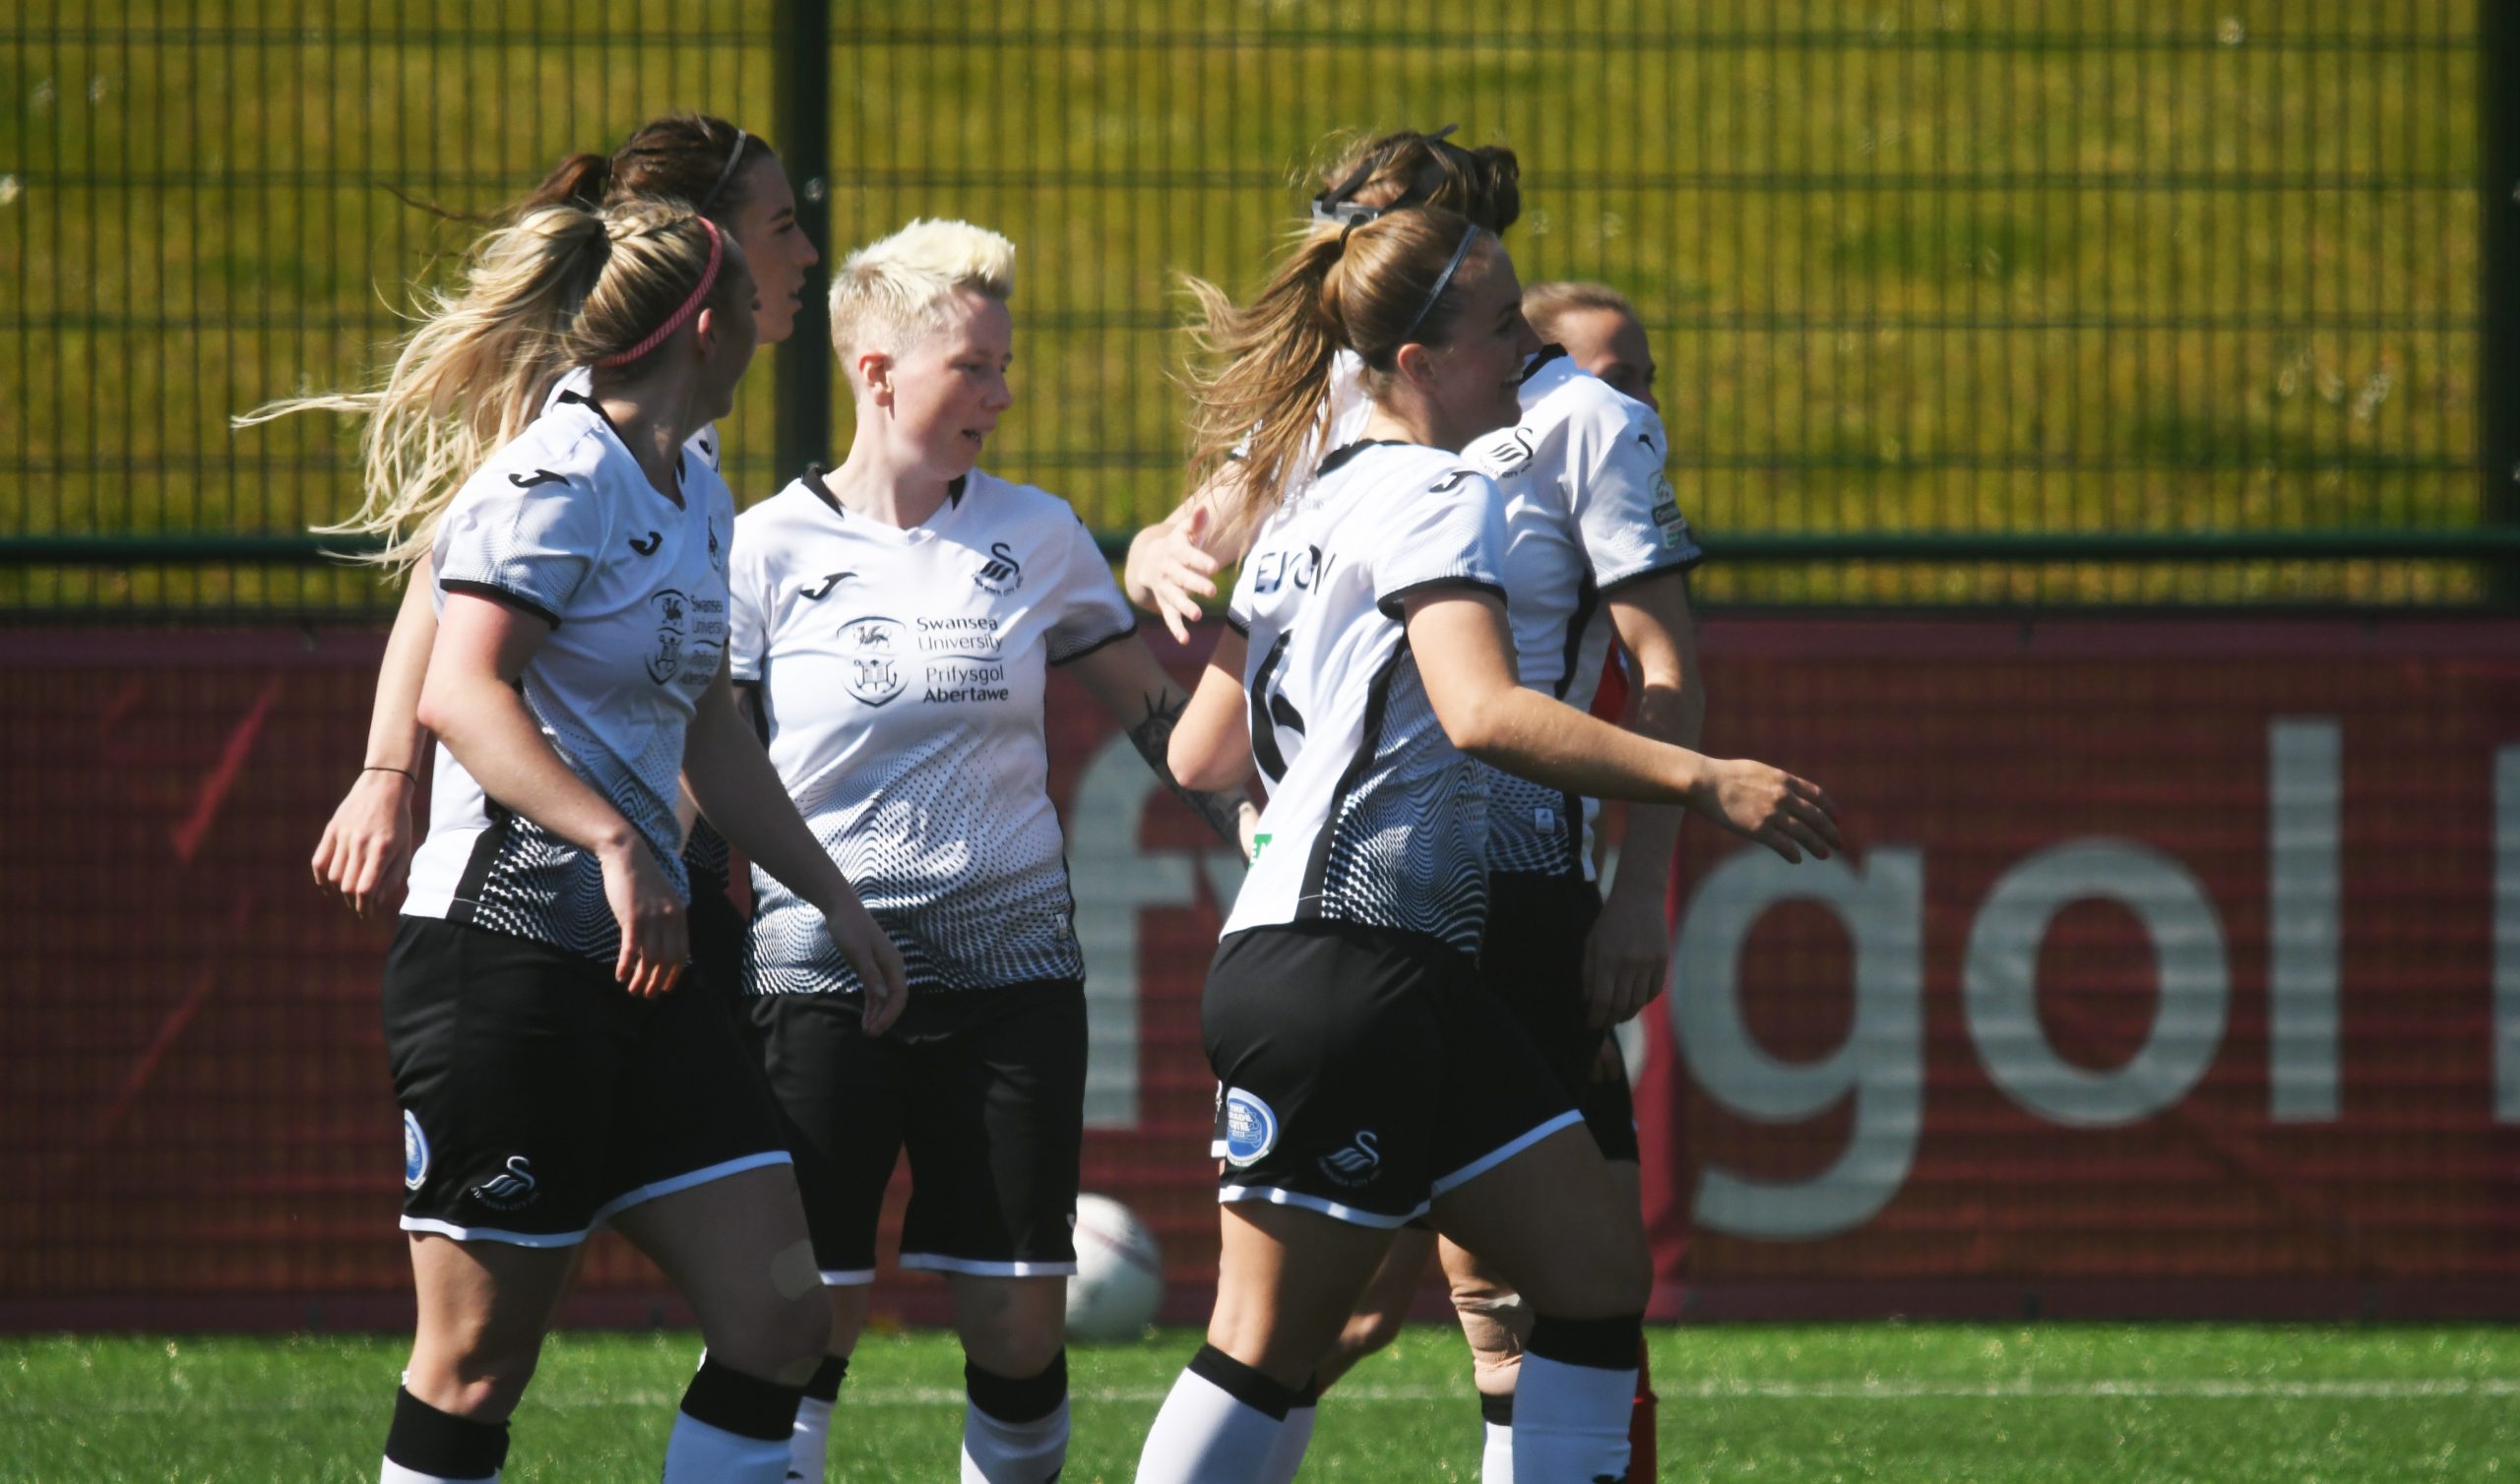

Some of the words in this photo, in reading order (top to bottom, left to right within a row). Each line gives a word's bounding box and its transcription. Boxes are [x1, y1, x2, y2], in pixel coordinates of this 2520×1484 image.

[916, 616, 999, 632] Swansea
[917, 634, 1003, 651] University
[925, 664, 1005, 685] Prifysgol
[922, 686, 1009, 704] Abertawe
[1071, 720, 2342, 1239] fgol
